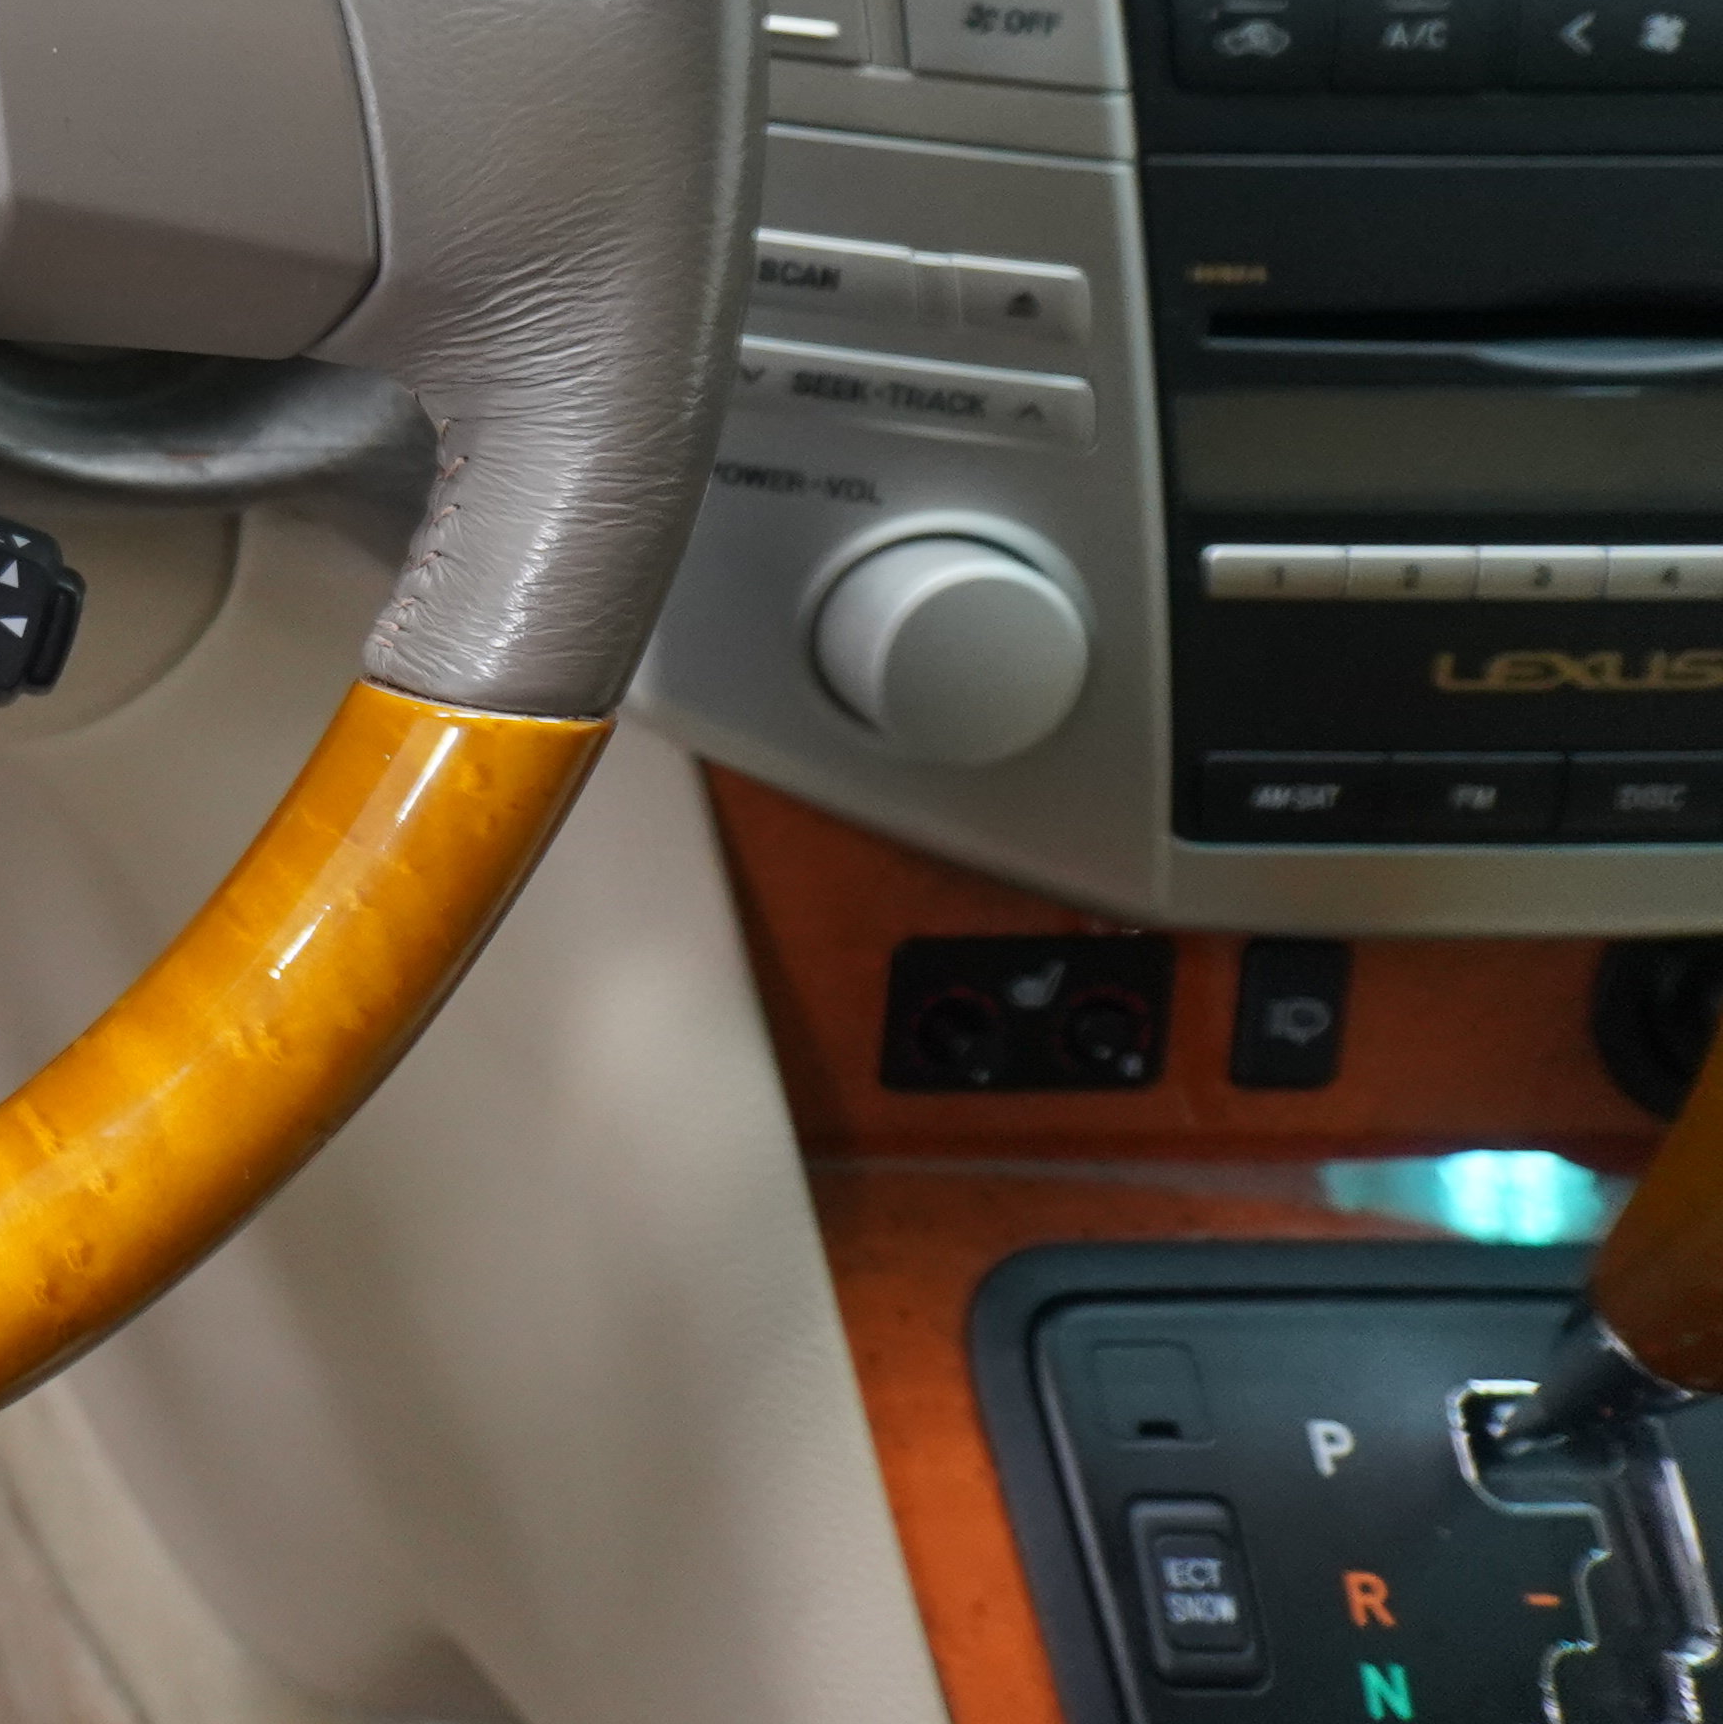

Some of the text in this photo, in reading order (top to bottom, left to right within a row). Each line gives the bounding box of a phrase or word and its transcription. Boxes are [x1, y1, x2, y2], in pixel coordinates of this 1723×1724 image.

[1003, 7, 1063, 38] OFF
[1383, 21, 1449, 50] A/C
[757, 259, 842, 292] SCAN
[1435, 651, 1723, 694] LEXUS
[1305, 1419, 1355, 1477] P
[1343, 1570, 1397, 1628] R
[1359, 1662, 1415, 1722] N
